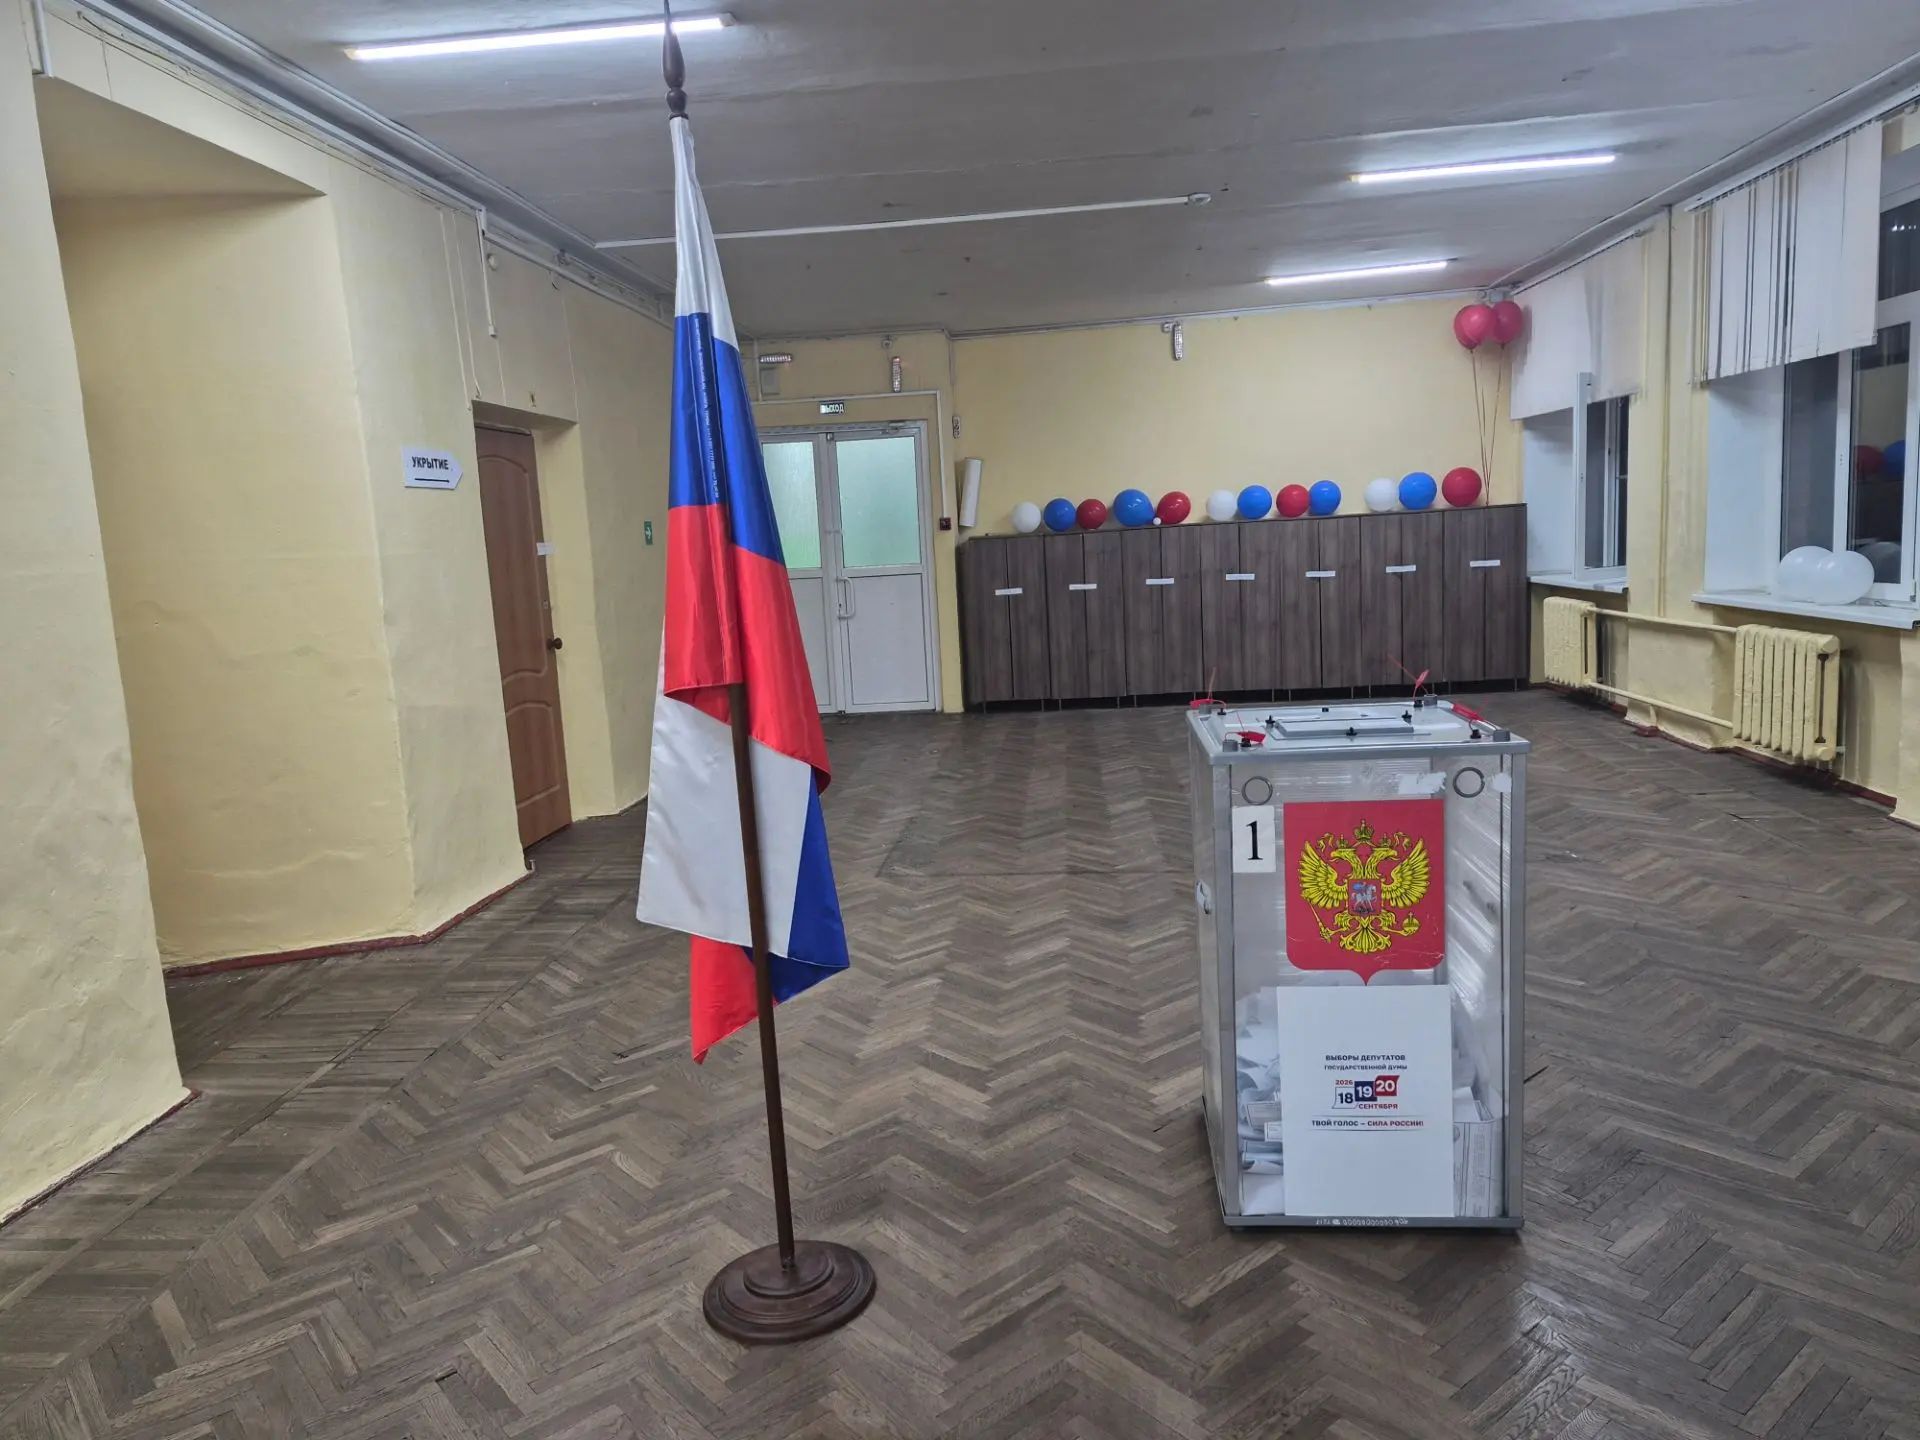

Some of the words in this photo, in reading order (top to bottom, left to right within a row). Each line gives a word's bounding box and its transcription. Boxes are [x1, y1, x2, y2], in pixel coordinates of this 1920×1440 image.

[411, 455, 449, 470] УКРЫТИЕ
[1246, 820, 1263, 860] 1
[1361, 1054, 1406, 1062] ДЕПУТАТОВ
[1337, 1092, 1354, 1104] 18
[1356, 1085, 1373, 1098] 19
[1375, 1079, 1396, 1092] 20
[1311, 1119, 1332, 1127] ТВОЙ
